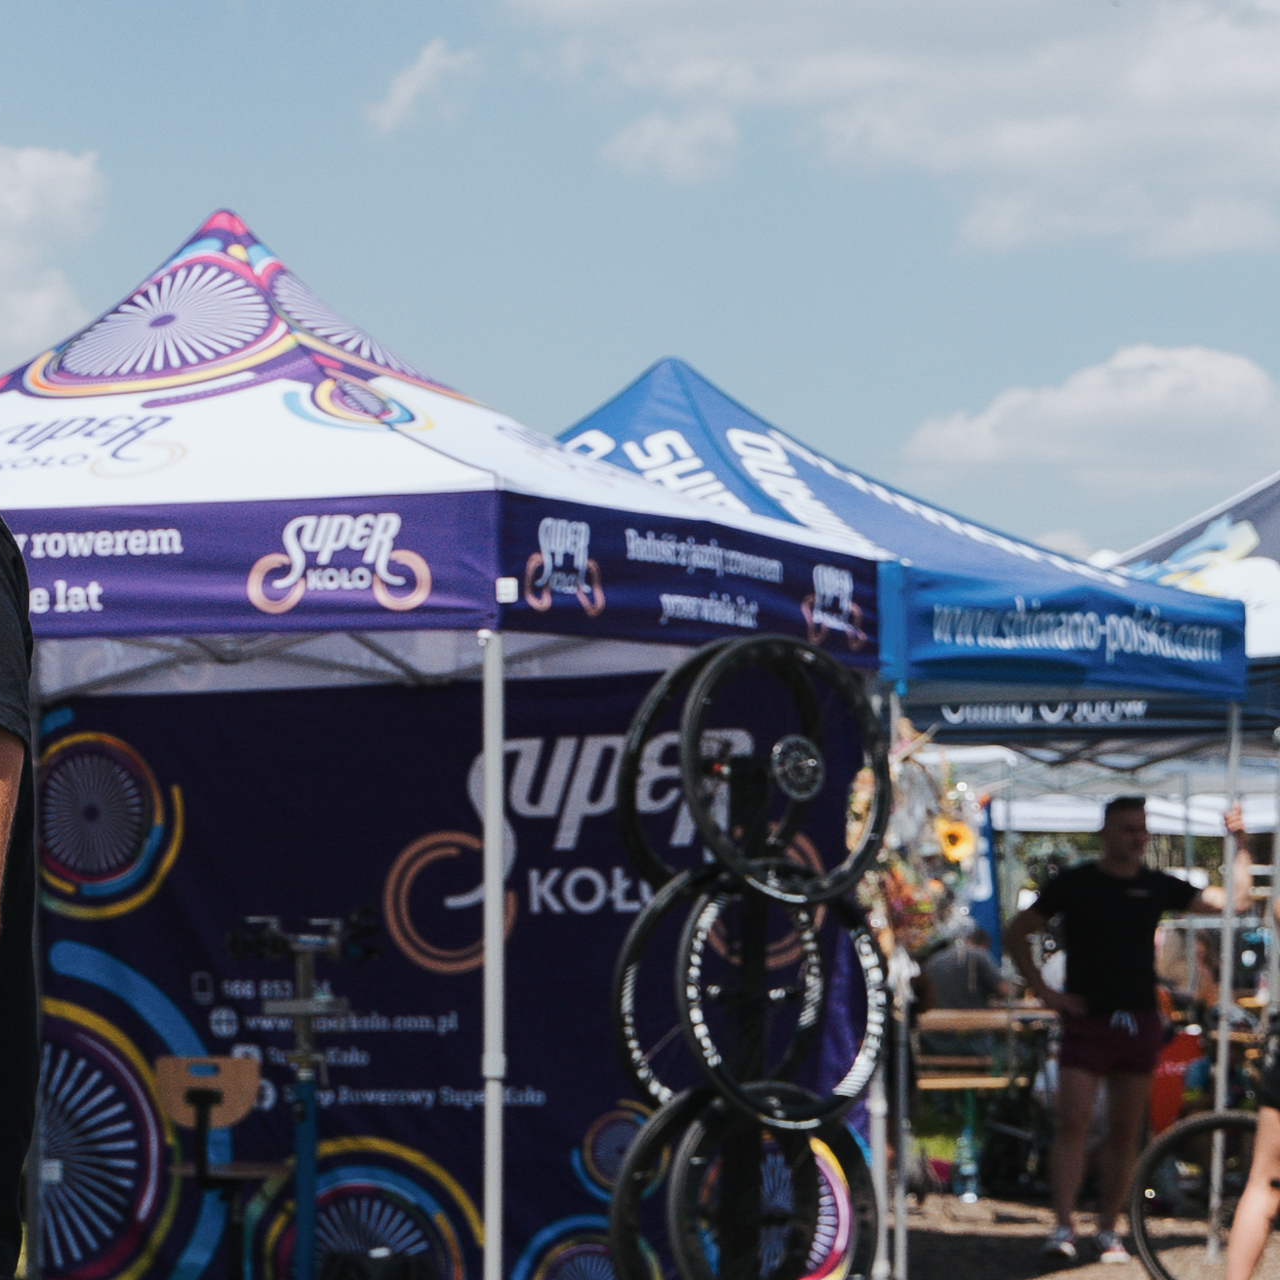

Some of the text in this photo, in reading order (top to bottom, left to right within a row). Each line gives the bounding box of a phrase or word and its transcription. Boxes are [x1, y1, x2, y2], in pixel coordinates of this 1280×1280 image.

[30, 527, 184, 558] rowerem
[54, 579, 103, 612] lat
[527, 866, 656, 914] KOŁ
